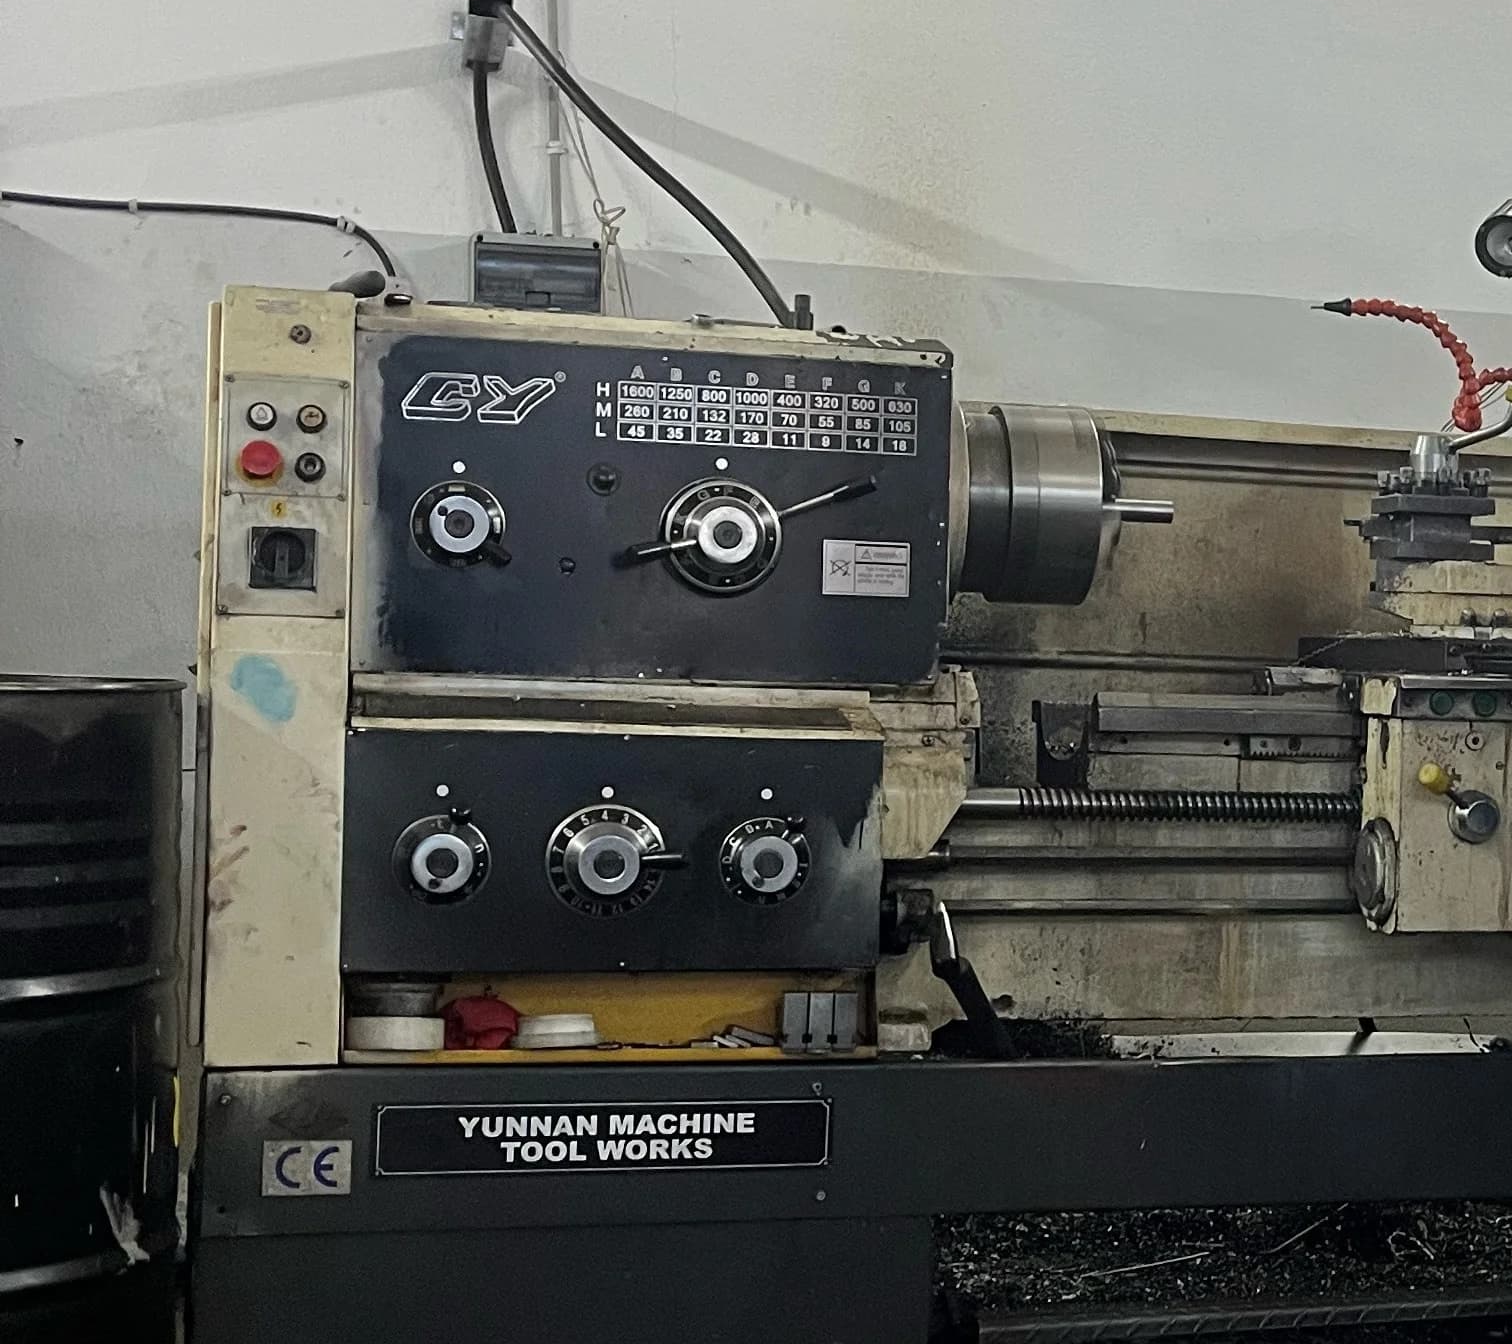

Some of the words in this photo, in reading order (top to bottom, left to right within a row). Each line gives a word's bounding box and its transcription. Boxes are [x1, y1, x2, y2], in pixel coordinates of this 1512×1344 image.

[631, 365, 645, 380] A
[670, 368, 682, 382] B
[708, 370, 721, 384] C
[746, 372, 759, 386] D
[784, 374, 796, 389] E
[822, 377, 832, 390] F
[858, 380, 870, 393] G
[894, 382, 906, 395] K
[596, 382, 610, 397] H
[622, 384, 654, 398] 1600
[661, 387, 693, 400] 1250
[701, 389, 726, 403] 800
[736, 392, 768, 405] 1000
[776, 394, 802, 407] 400
[814, 396, 838, 409] 320
[851, 398, 876, 412] 500
[596, 402, 612, 418] M
[624, 404, 650, 418] 260
[662, 407, 688, 420] 210
[702, 410, 726, 422] 132
[740, 412, 765, 424] 170
[780, 413, 798, 426] 70
[818, 416, 834, 428] 55
[854, 418, 872, 430] 85
[888, 420, 912, 433] 105
[595, 422, 607, 438] L
[627, 424, 646, 438] 45
[666, 427, 684, 440] 35
[704, 429, 722, 442] 22
[742, 431, 760, 444] 28
[782, 433, 796, 446] 11
[855, 438, 870, 450] 14
[580, 814, 590, 826] 5
[602, 810, 608, 820] 4
[621, 814, 630, 824] 3
[764, 820, 774, 830] A
[458, 1115, 598, 1139] YUNNAN
[607, 1112, 756, 1136] MACHINE
[500, 1140, 588, 1164] TOOL
[595, 1137, 714, 1161] WORKS
[274, 1145, 340, 1189] CE
